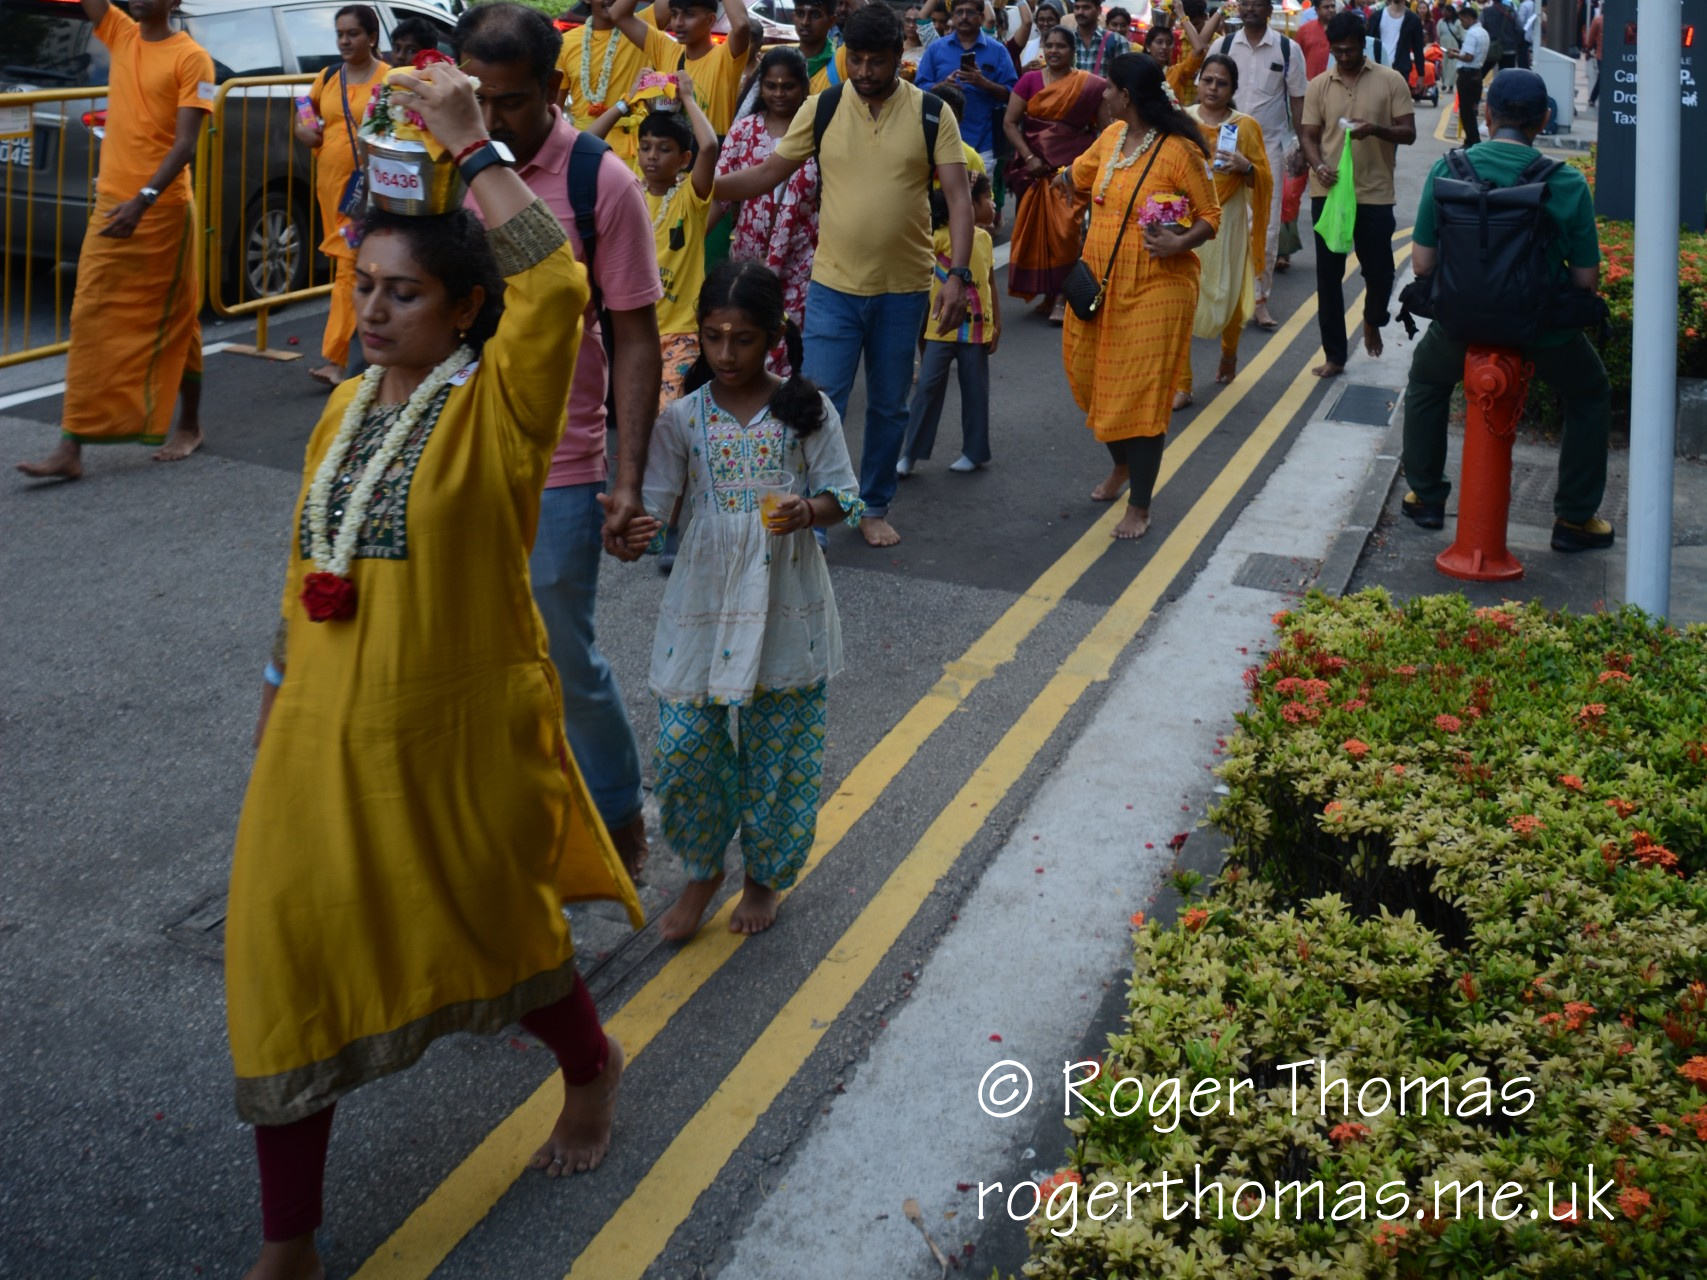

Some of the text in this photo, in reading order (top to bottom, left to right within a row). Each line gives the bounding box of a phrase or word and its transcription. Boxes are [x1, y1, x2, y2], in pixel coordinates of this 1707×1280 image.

[1613, 90, 1637, 104] Dro
[1612, 111, 1637, 125] Tax
[374, 169, 419, 189] 06436
